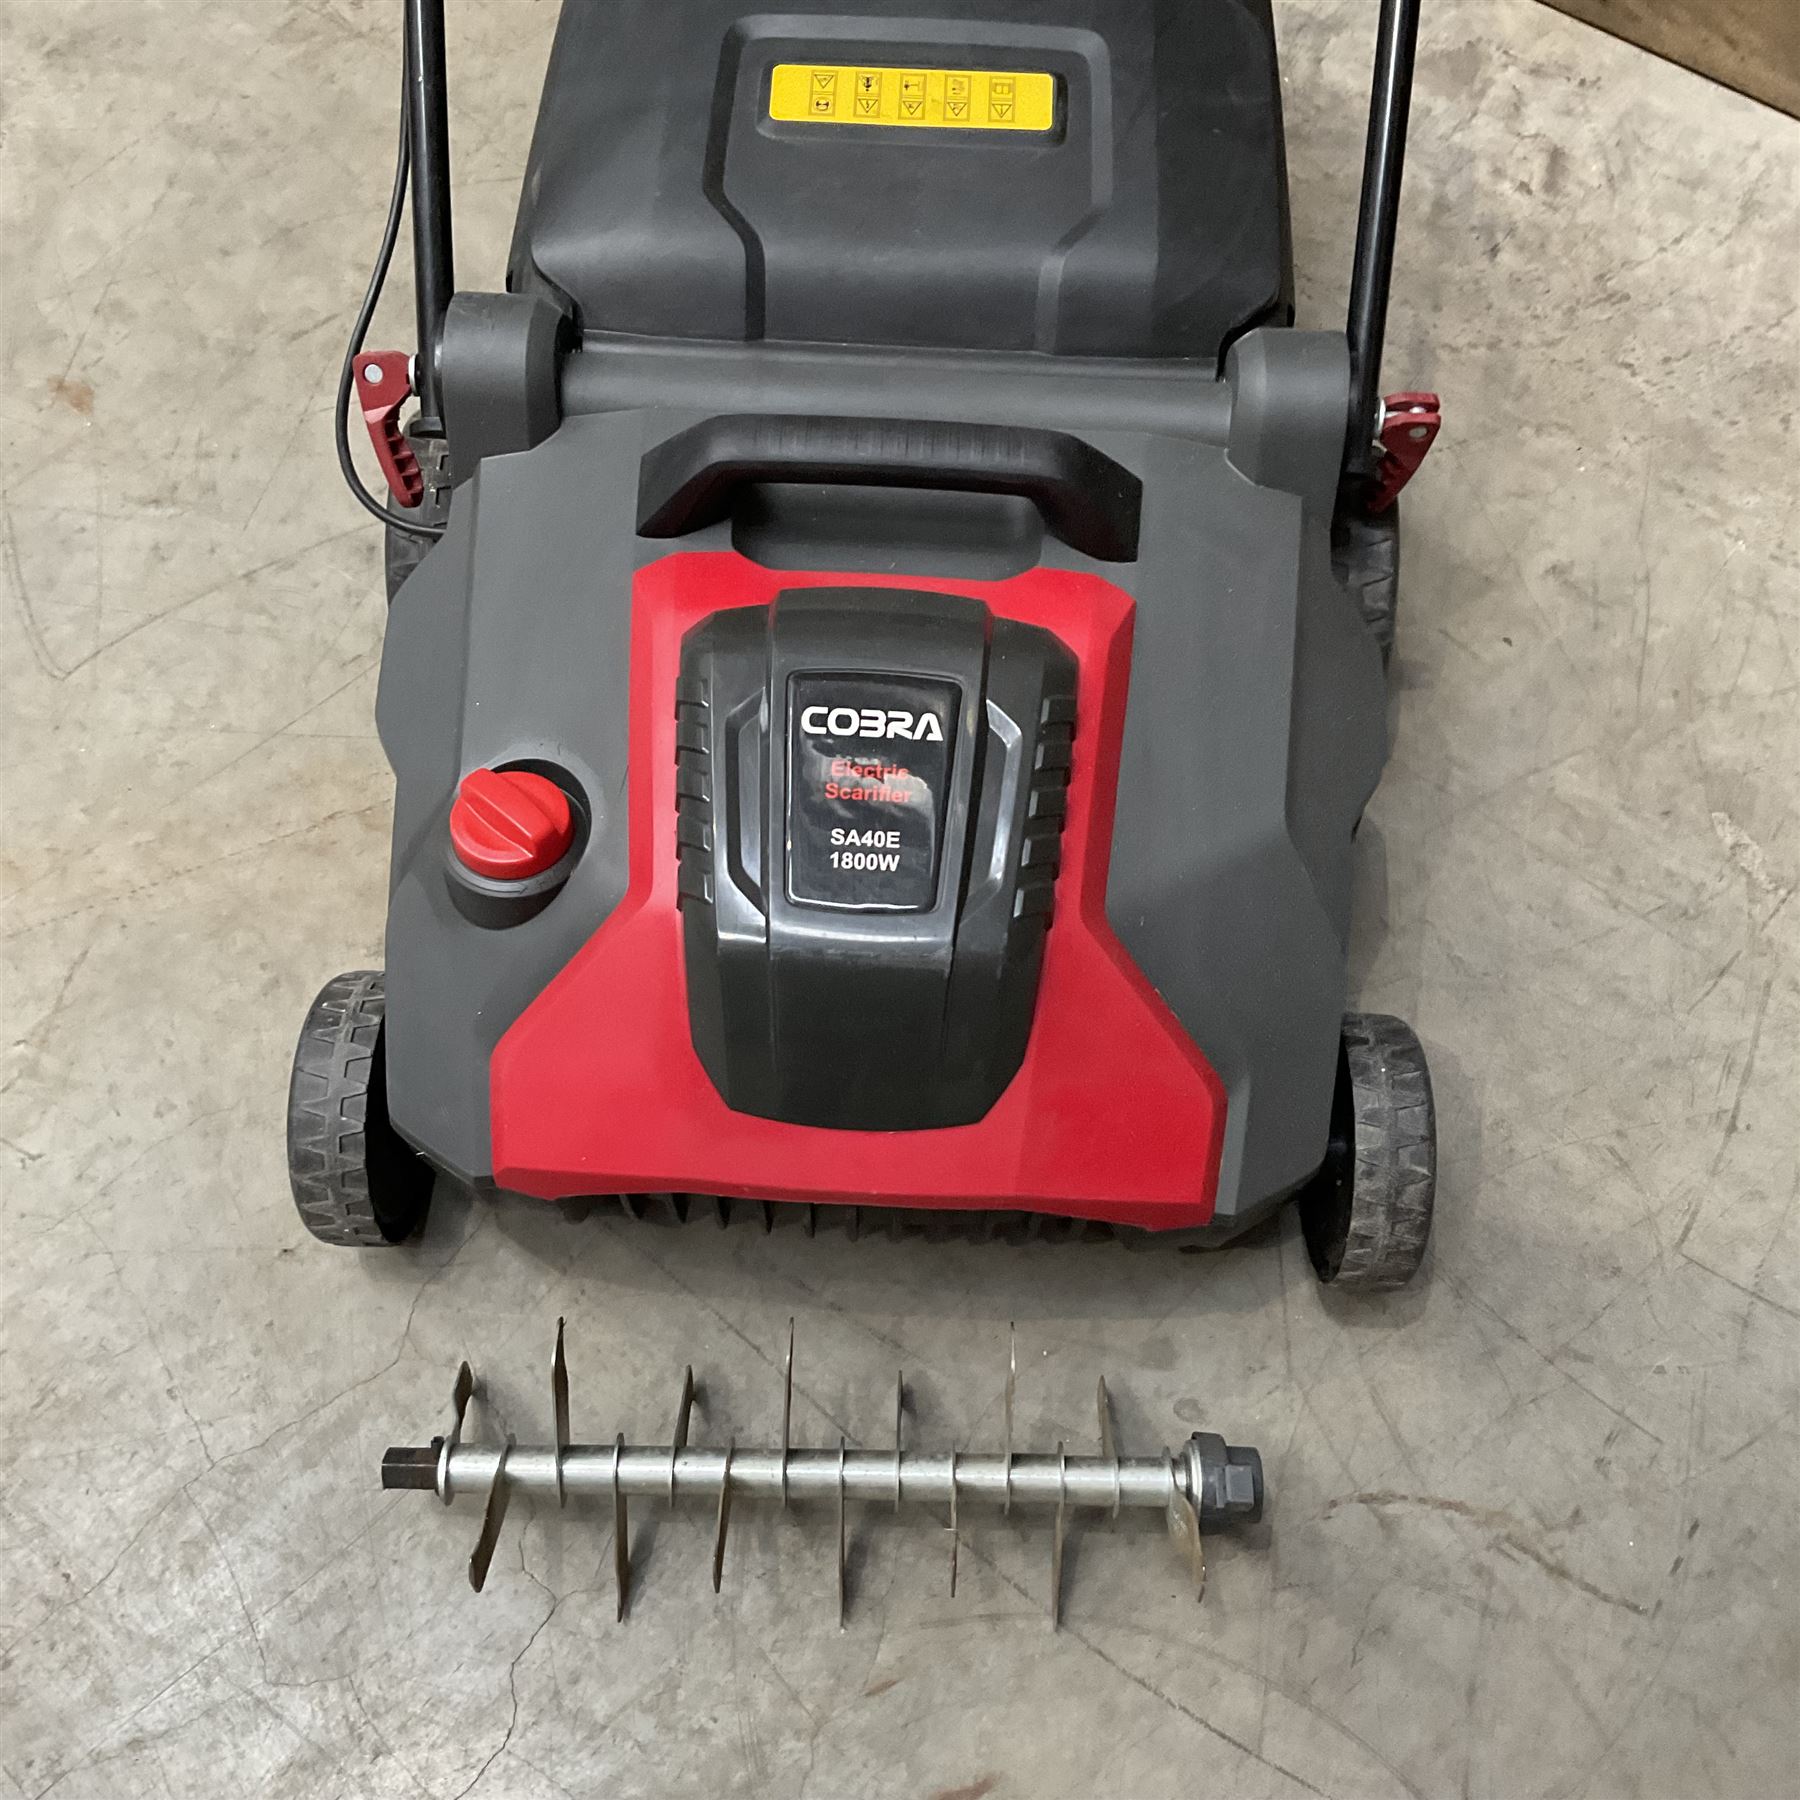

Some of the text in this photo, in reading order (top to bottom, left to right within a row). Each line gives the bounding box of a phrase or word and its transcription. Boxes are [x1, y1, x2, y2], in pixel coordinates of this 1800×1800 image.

[801, 706, 944, 741] COBRA
[831, 759, 909, 779] Electric
[825, 783, 912, 803] Scarifier
[830, 828, 901, 848] SA40E
[829, 852, 900, 871] 1800W
